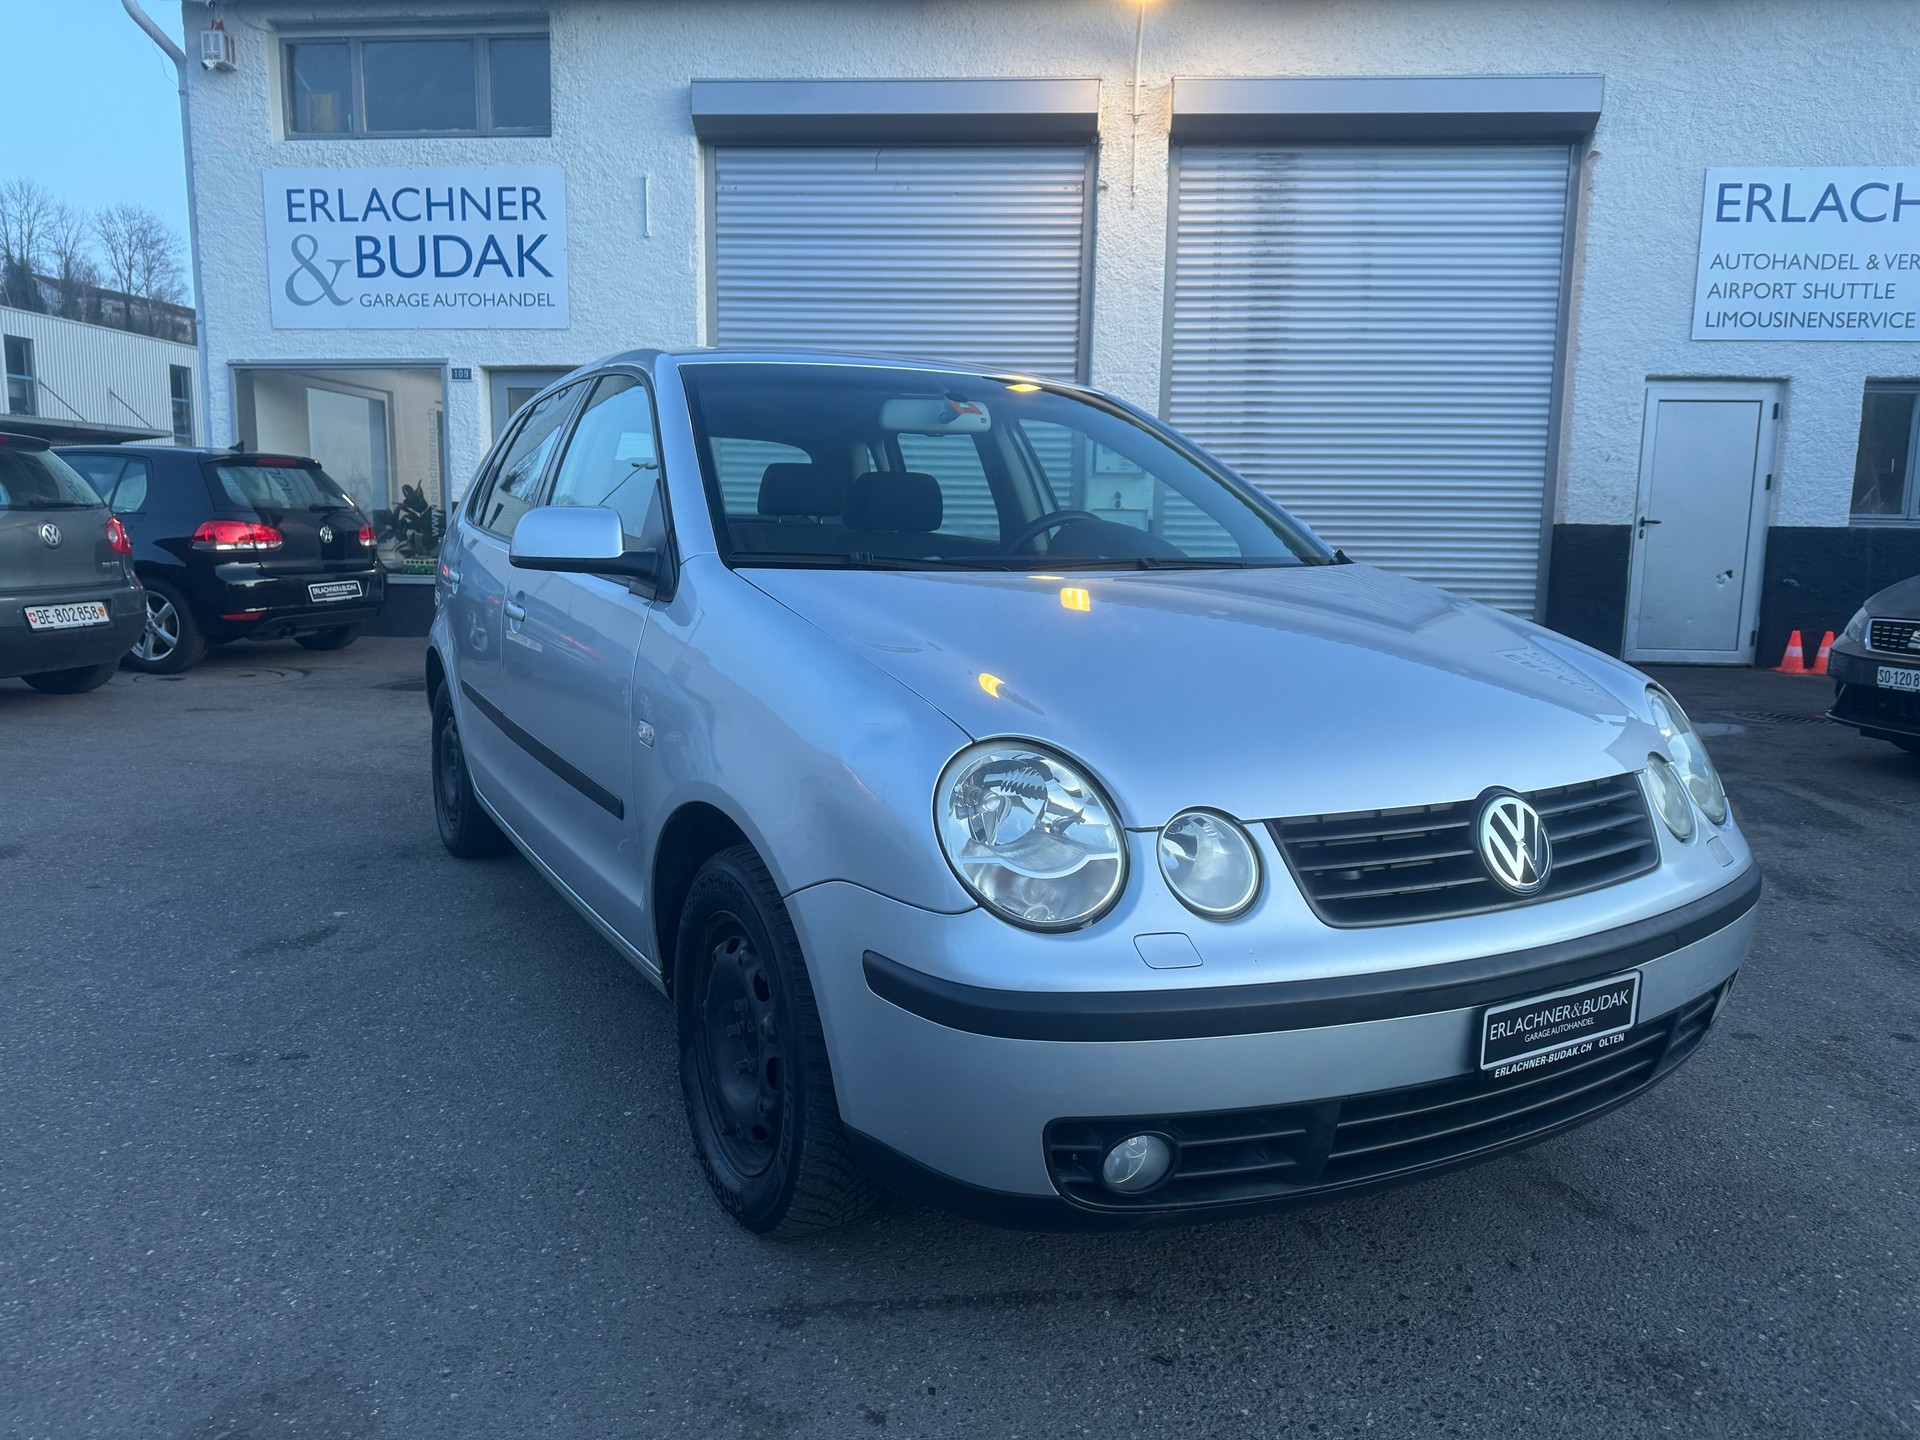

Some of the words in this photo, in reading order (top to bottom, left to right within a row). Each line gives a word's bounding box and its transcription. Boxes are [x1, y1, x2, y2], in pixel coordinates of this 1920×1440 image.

[286, 186, 547, 222] ERLACHNER
[1715, 182, 1920, 223] ERLACH
[285, 234, 353, 306] &
[355, 234, 554, 278] BUDAK
[1710, 253, 1859, 270] AUTOHANDEL
[1866, 254, 1880, 270] &
[1884, 253, 1920, 270] VER
[359, 293, 429, 307] GARAGE
[433, 292, 555, 307] AUTOHANDEL
[1707, 283, 1797, 299] AIRPORT
[1802, 283, 1896, 299] SHUTTLE
[1705, 311, 1916, 328] LIMOUSINENSERVICE
[454, 370, 469, 378] 109
[1490, 989, 1630, 1041] ERLACHNER&BUDAK
[1524, 1028, 1551, 1043] GARAGE
[1550, 1016, 1595, 1036] AUTOHANDEL
[1494, 1042, 1593, 1079] ERLACHNER-BUDAK.CH
[1598, 1033, 1625, 1048] OLTEN
